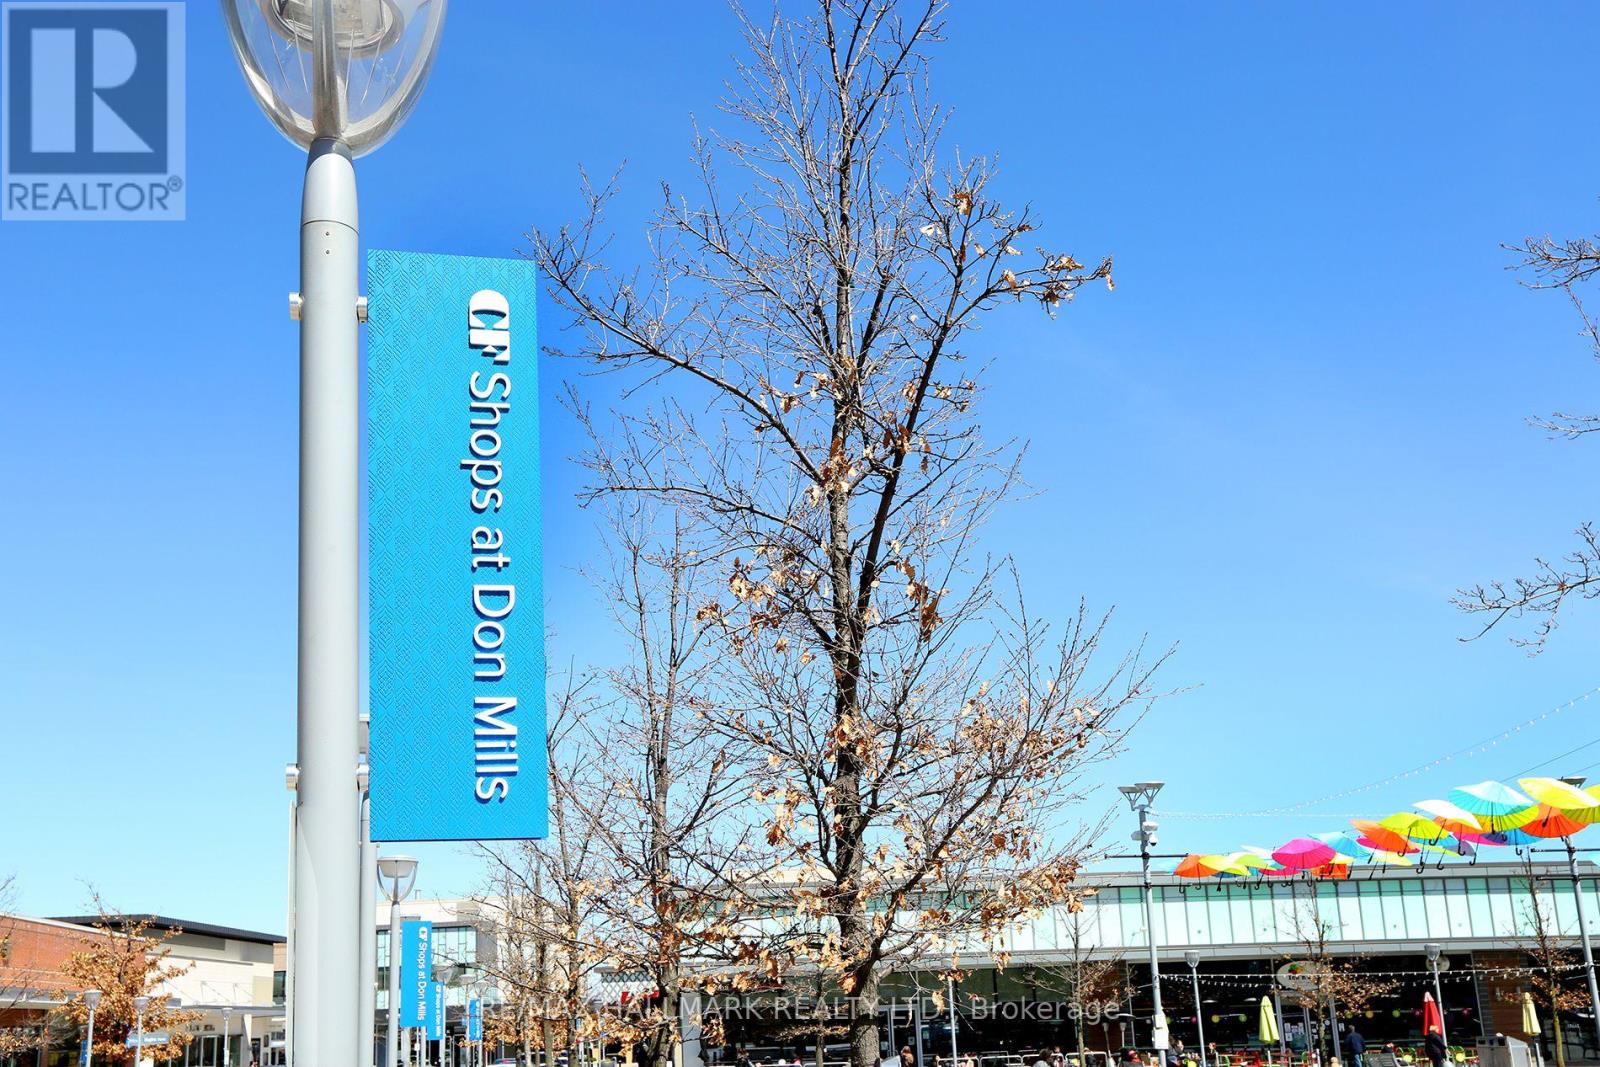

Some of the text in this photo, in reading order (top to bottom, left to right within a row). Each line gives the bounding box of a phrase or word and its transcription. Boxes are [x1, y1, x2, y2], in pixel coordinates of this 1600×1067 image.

[460, 289, 519, 801] CF Shops at Don Mills
[417, 942, 427, 969] Shops
[418, 971, 426, 980] at
[418, 981, 427, 1000] Don
[417, 1001, 427, 1021] Mills
